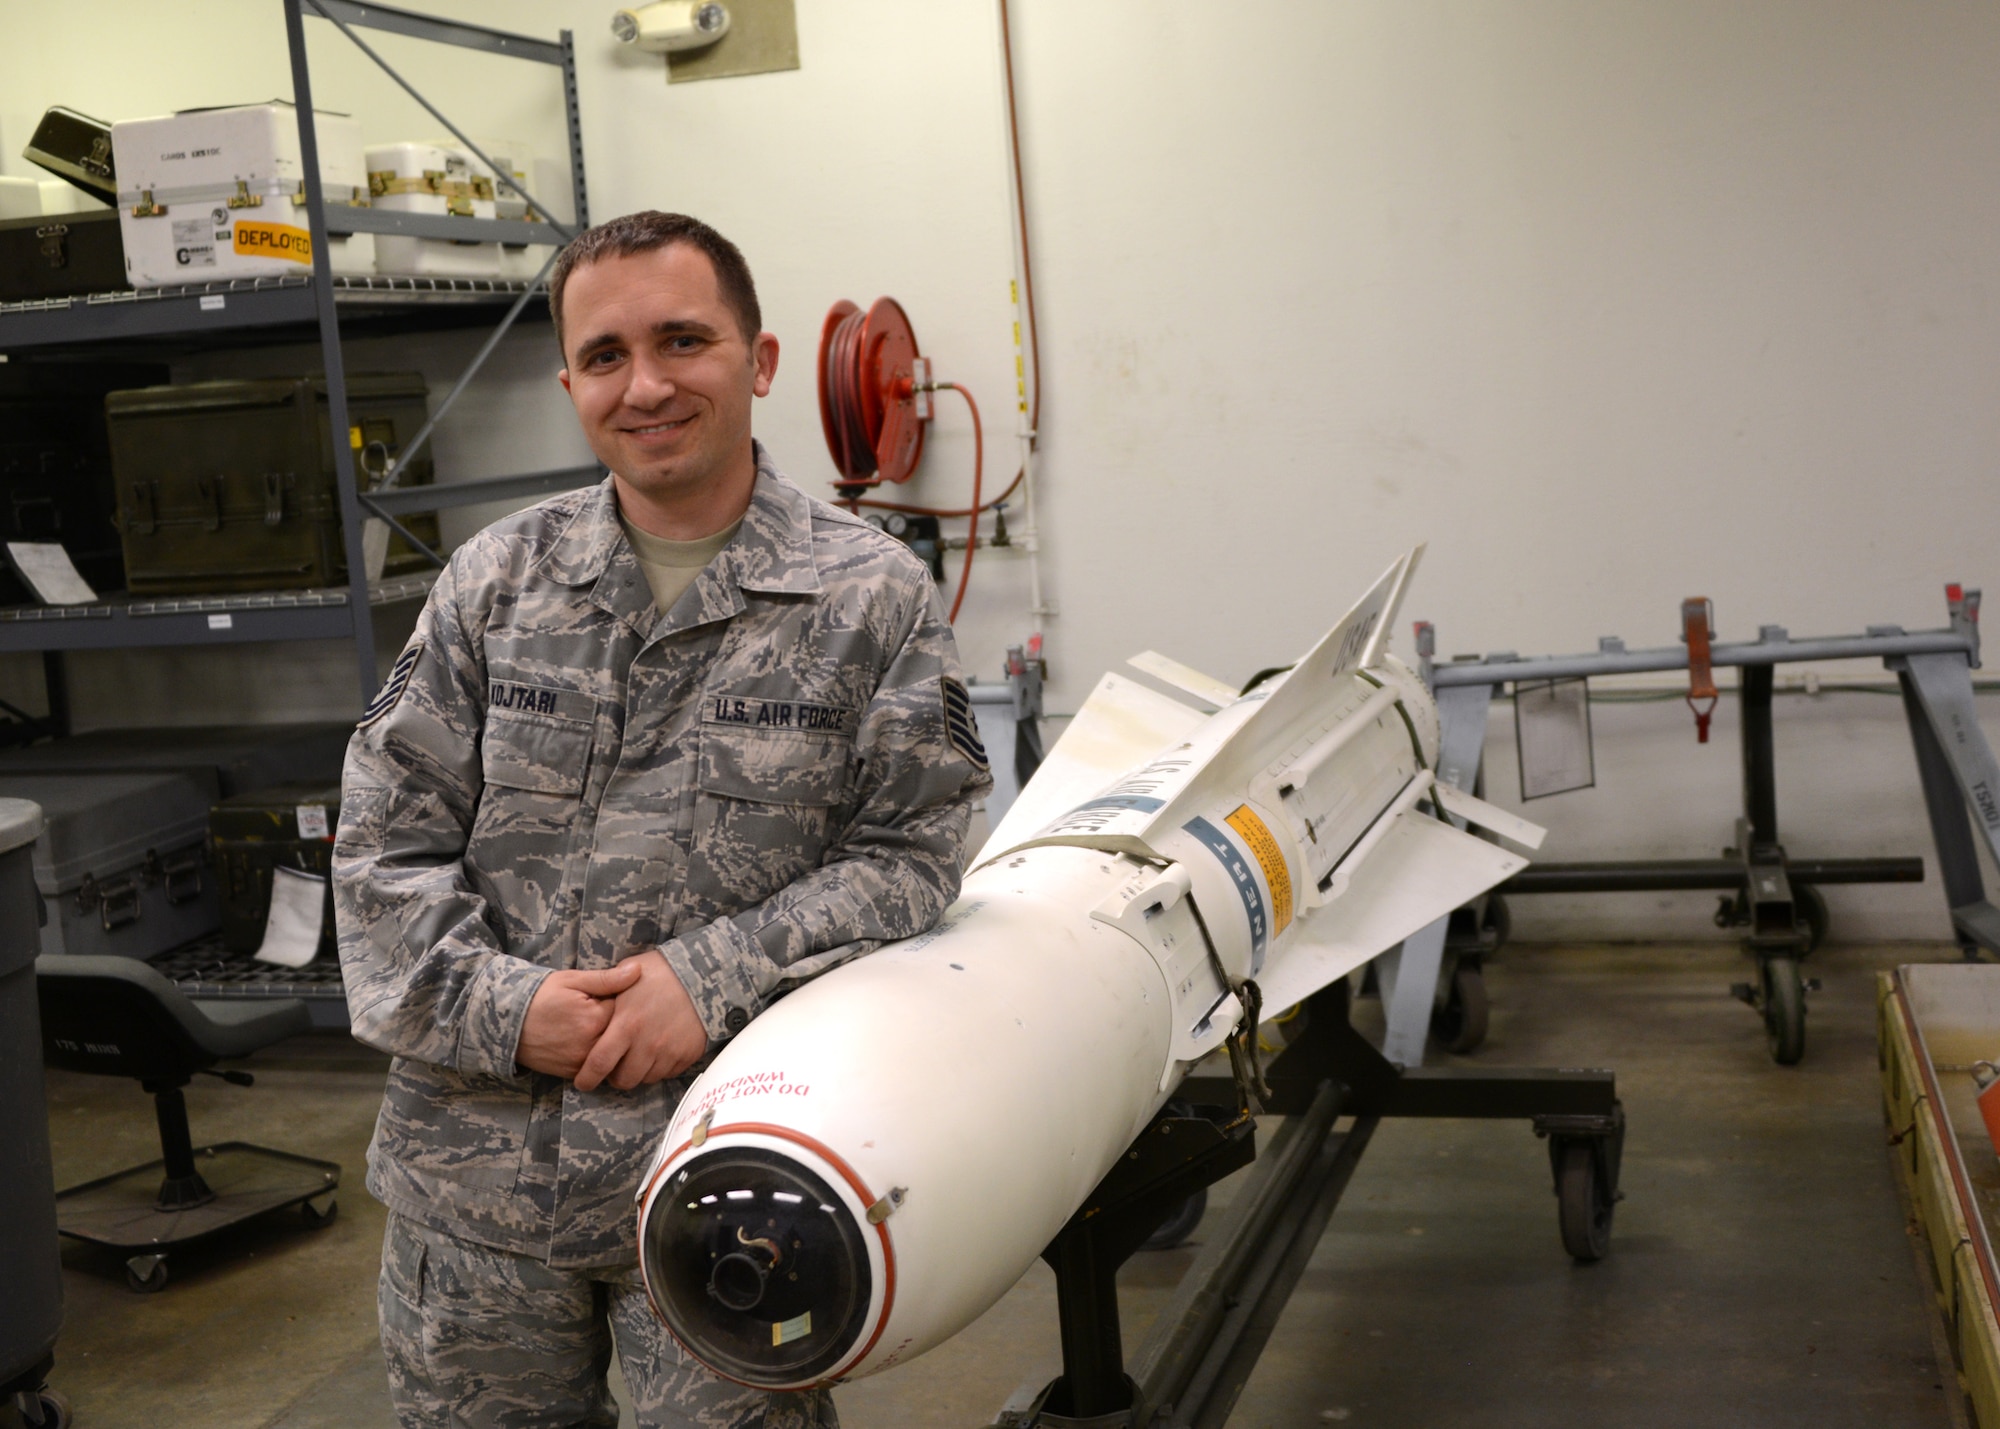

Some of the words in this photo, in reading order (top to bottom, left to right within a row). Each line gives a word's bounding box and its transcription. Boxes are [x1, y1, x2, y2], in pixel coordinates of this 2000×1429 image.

[238, 229, 310, 255] DEPLOYED
[715, 699, 749, 723] U.S.
[757, 703, 791, 726] AIR
[798, 704, 846, 730] FORCE
[1212, 841, 1264, 952] INERT
[700, 1071, 785, 1102] WINDOW
[731, 1084, 774, 1100] NOT
[778, 1083, 810, 1097] DO
